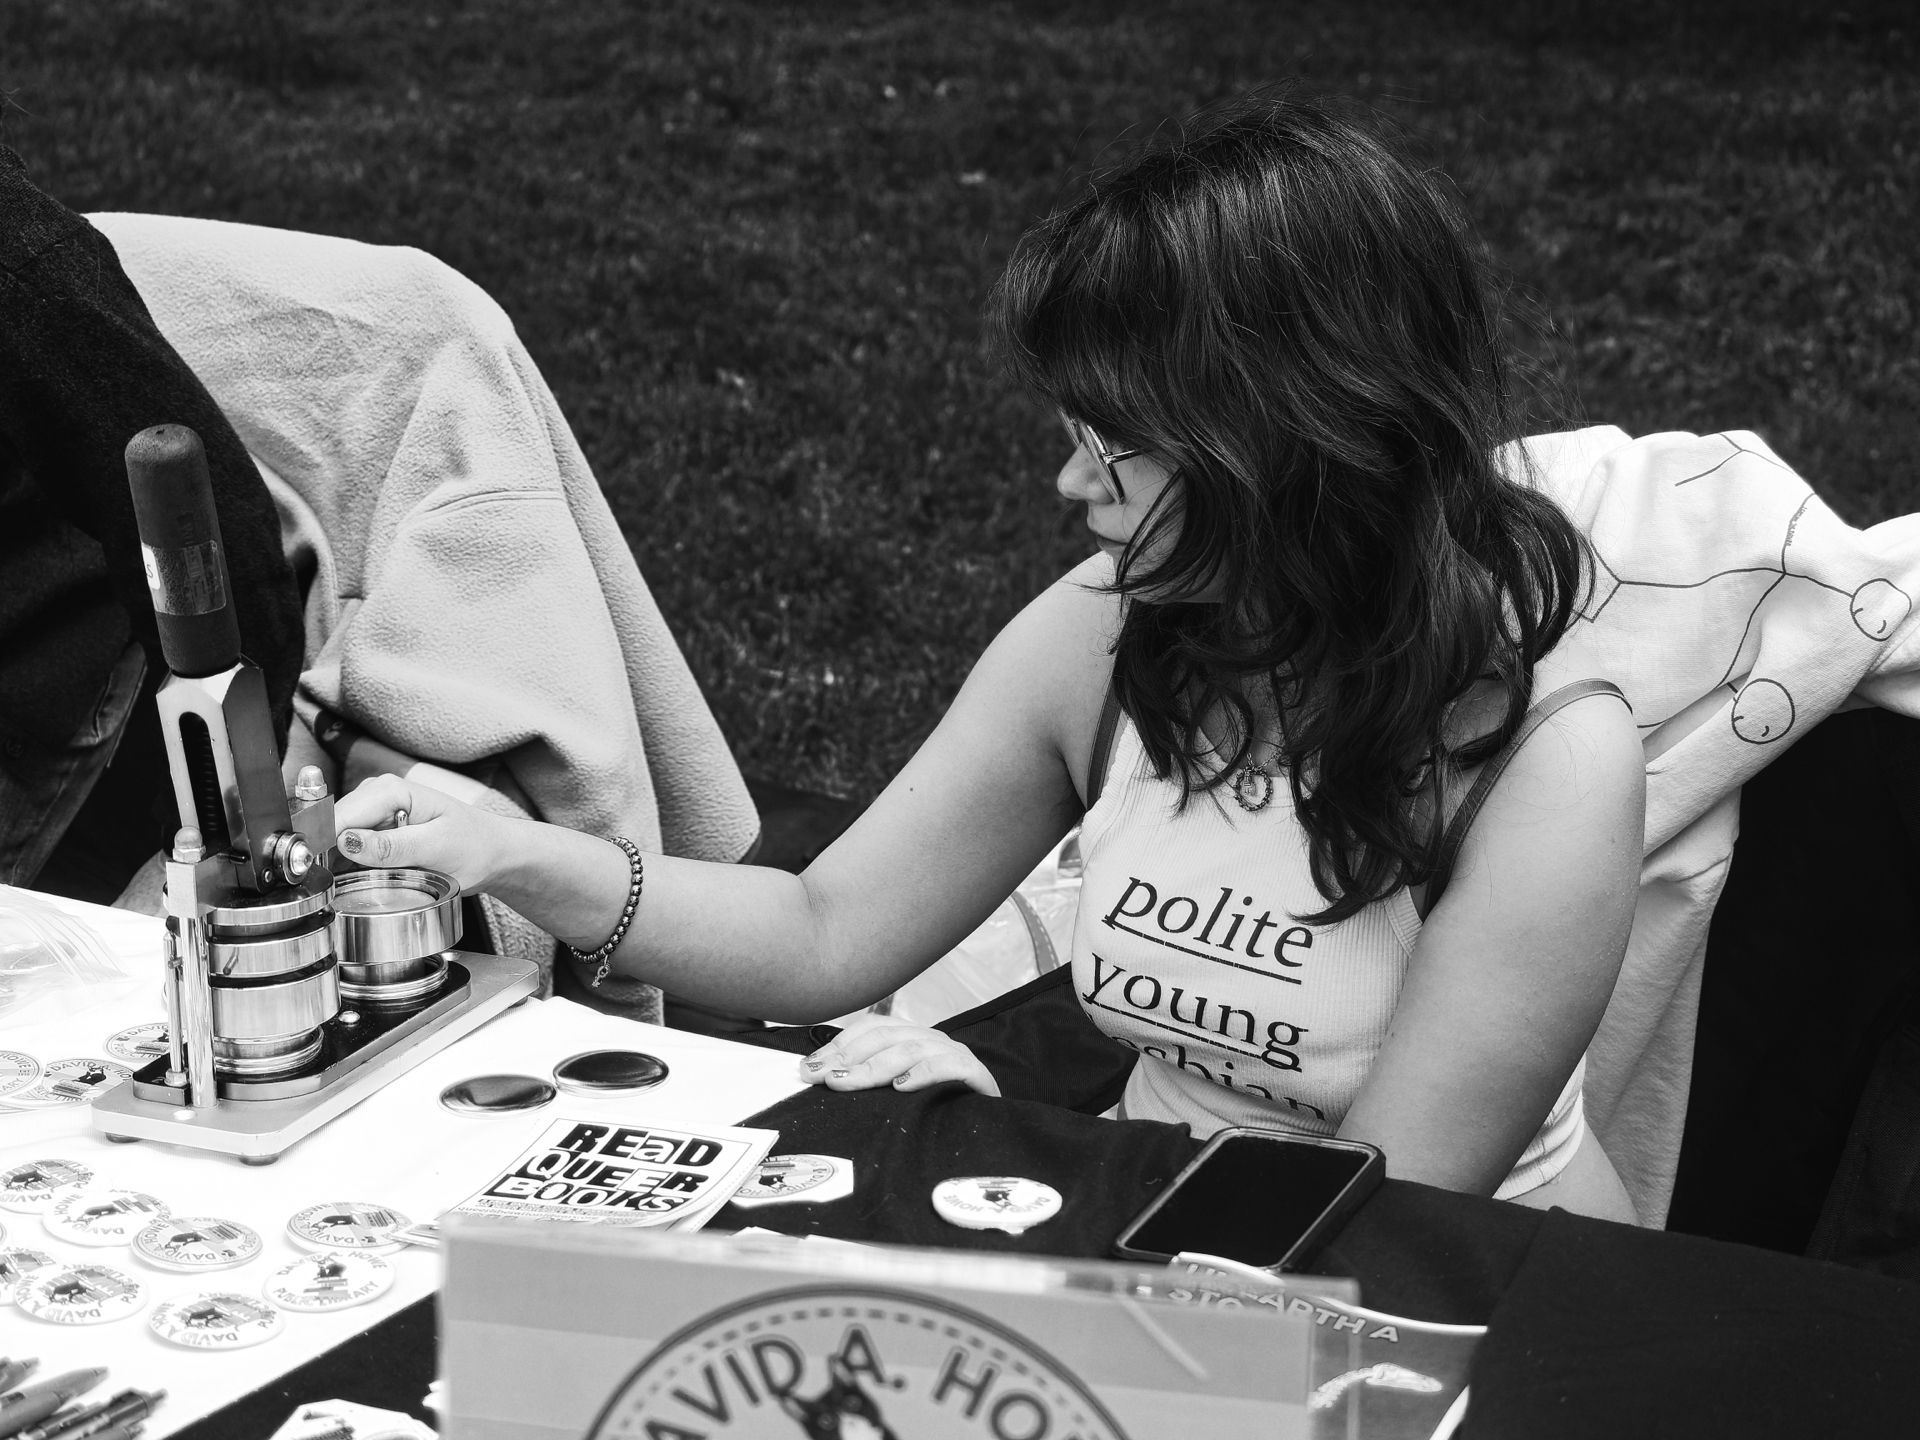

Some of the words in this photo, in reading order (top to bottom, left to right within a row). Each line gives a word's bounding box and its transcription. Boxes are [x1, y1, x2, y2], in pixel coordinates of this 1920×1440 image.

[1102, 876, 1313, 968] polite
[1082, 952, 1309, 1073] young
[50, 1061, 97, 1072] DAVID
[483, 1173, 694, 1212] BOOKS
[514, 1148, 709, 1193] QUEER
[932, 1351, 1056, 1440] HO
